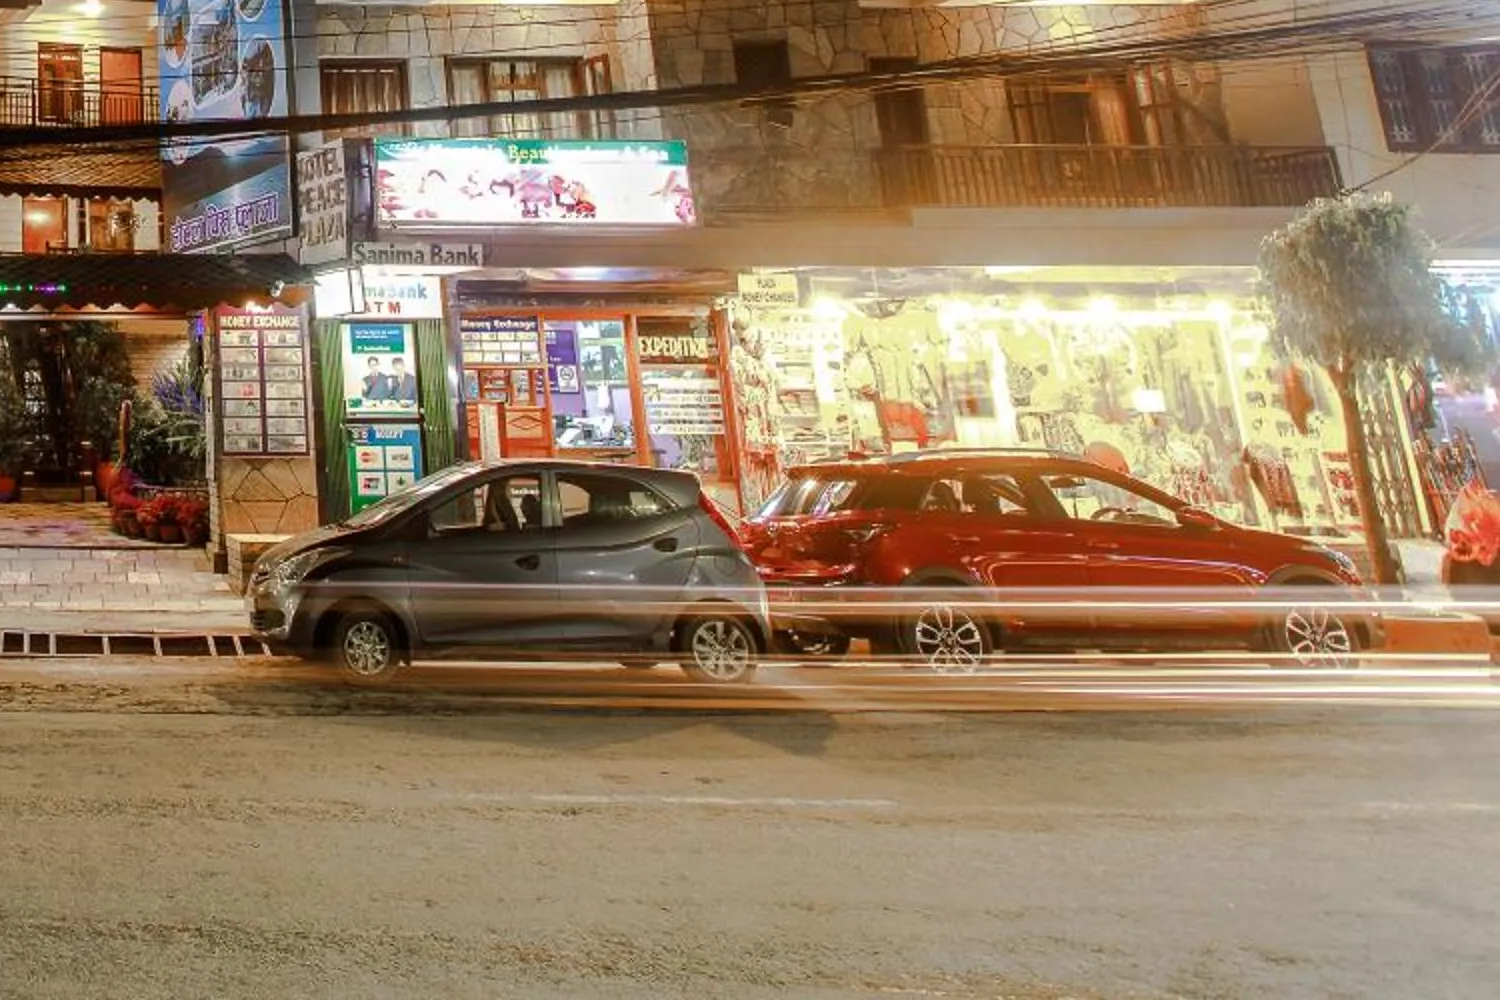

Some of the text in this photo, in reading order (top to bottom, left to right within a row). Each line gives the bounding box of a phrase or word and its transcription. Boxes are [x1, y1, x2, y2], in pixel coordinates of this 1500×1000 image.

[299, 148, 342, 183] HOTEL
[299, 177, 344, 214] PEACE
[299, 211, 344, 249] PLAZA
[353, 242, 479, 265] Sanima Bank
[219, 315, 299, 329] MONEY EXCHANGE
